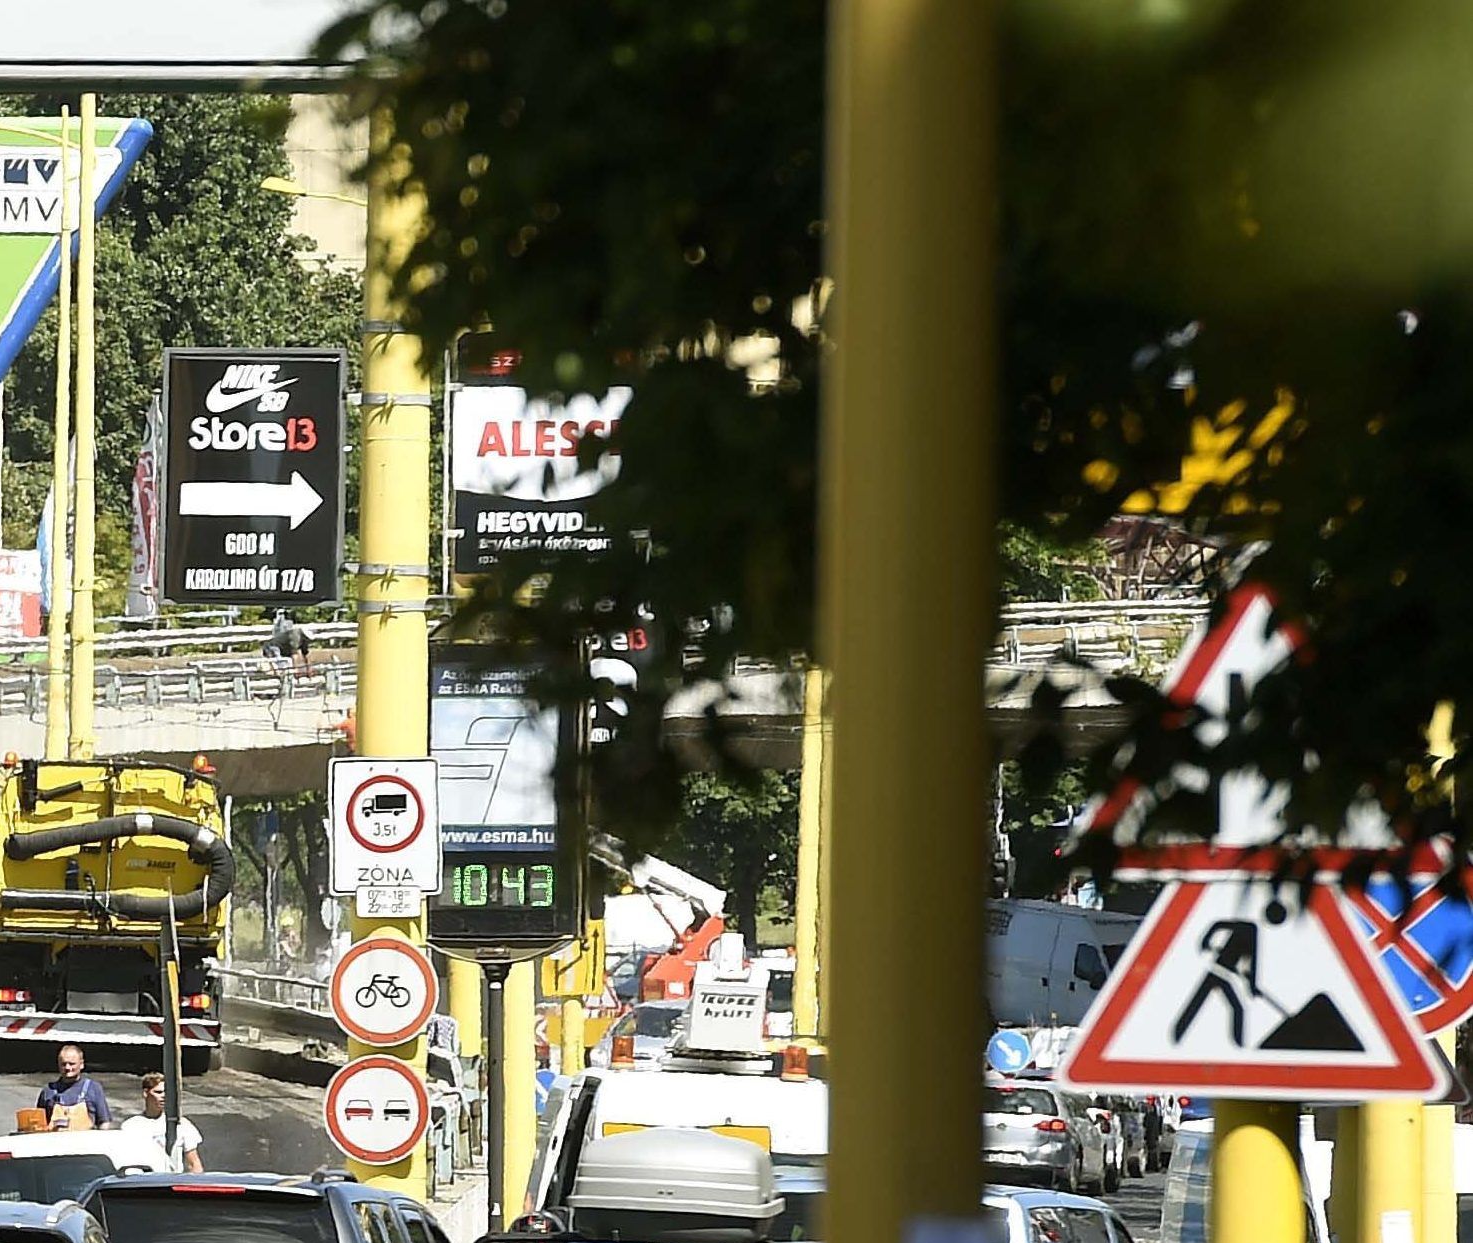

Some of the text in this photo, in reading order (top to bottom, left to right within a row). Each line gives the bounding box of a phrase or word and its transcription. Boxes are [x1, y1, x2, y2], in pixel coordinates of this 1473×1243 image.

[220, 364, 281, 388] NIKE
[188, 416, 318, 451] Store13
[225, 533, 257, 555] 600
[185, 569, 257, 591] KAROLINA
[258, 565, 280, 591] ÚT
[358, 864, 414, 881] ZÓNA
